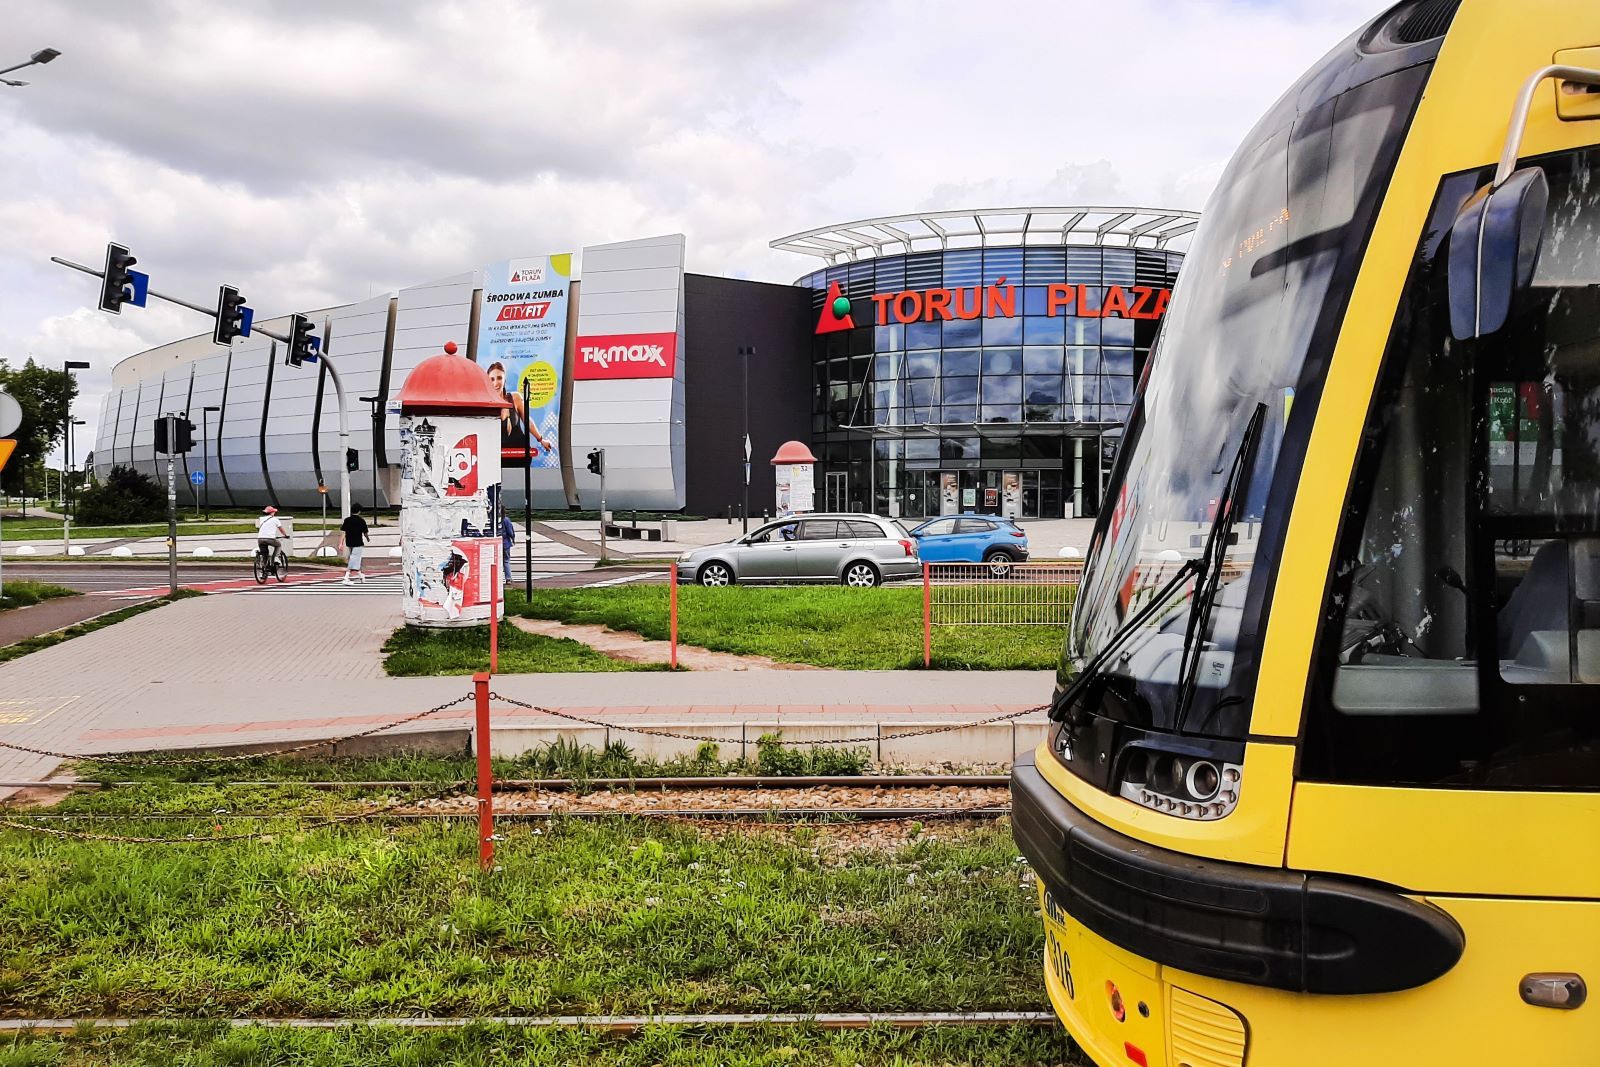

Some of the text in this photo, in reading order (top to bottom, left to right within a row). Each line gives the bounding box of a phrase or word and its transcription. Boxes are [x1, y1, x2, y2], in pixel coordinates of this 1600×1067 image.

[521, 267, 542, 275] TORUŃ
[487, 289, 564, 302] ŚRODOWA ZUMBA
[872, 277, 1016, 325] TORUŃ
[502, 305, 544, 318] CITYFIT
[1049, 929, 1074, 1000] 316
